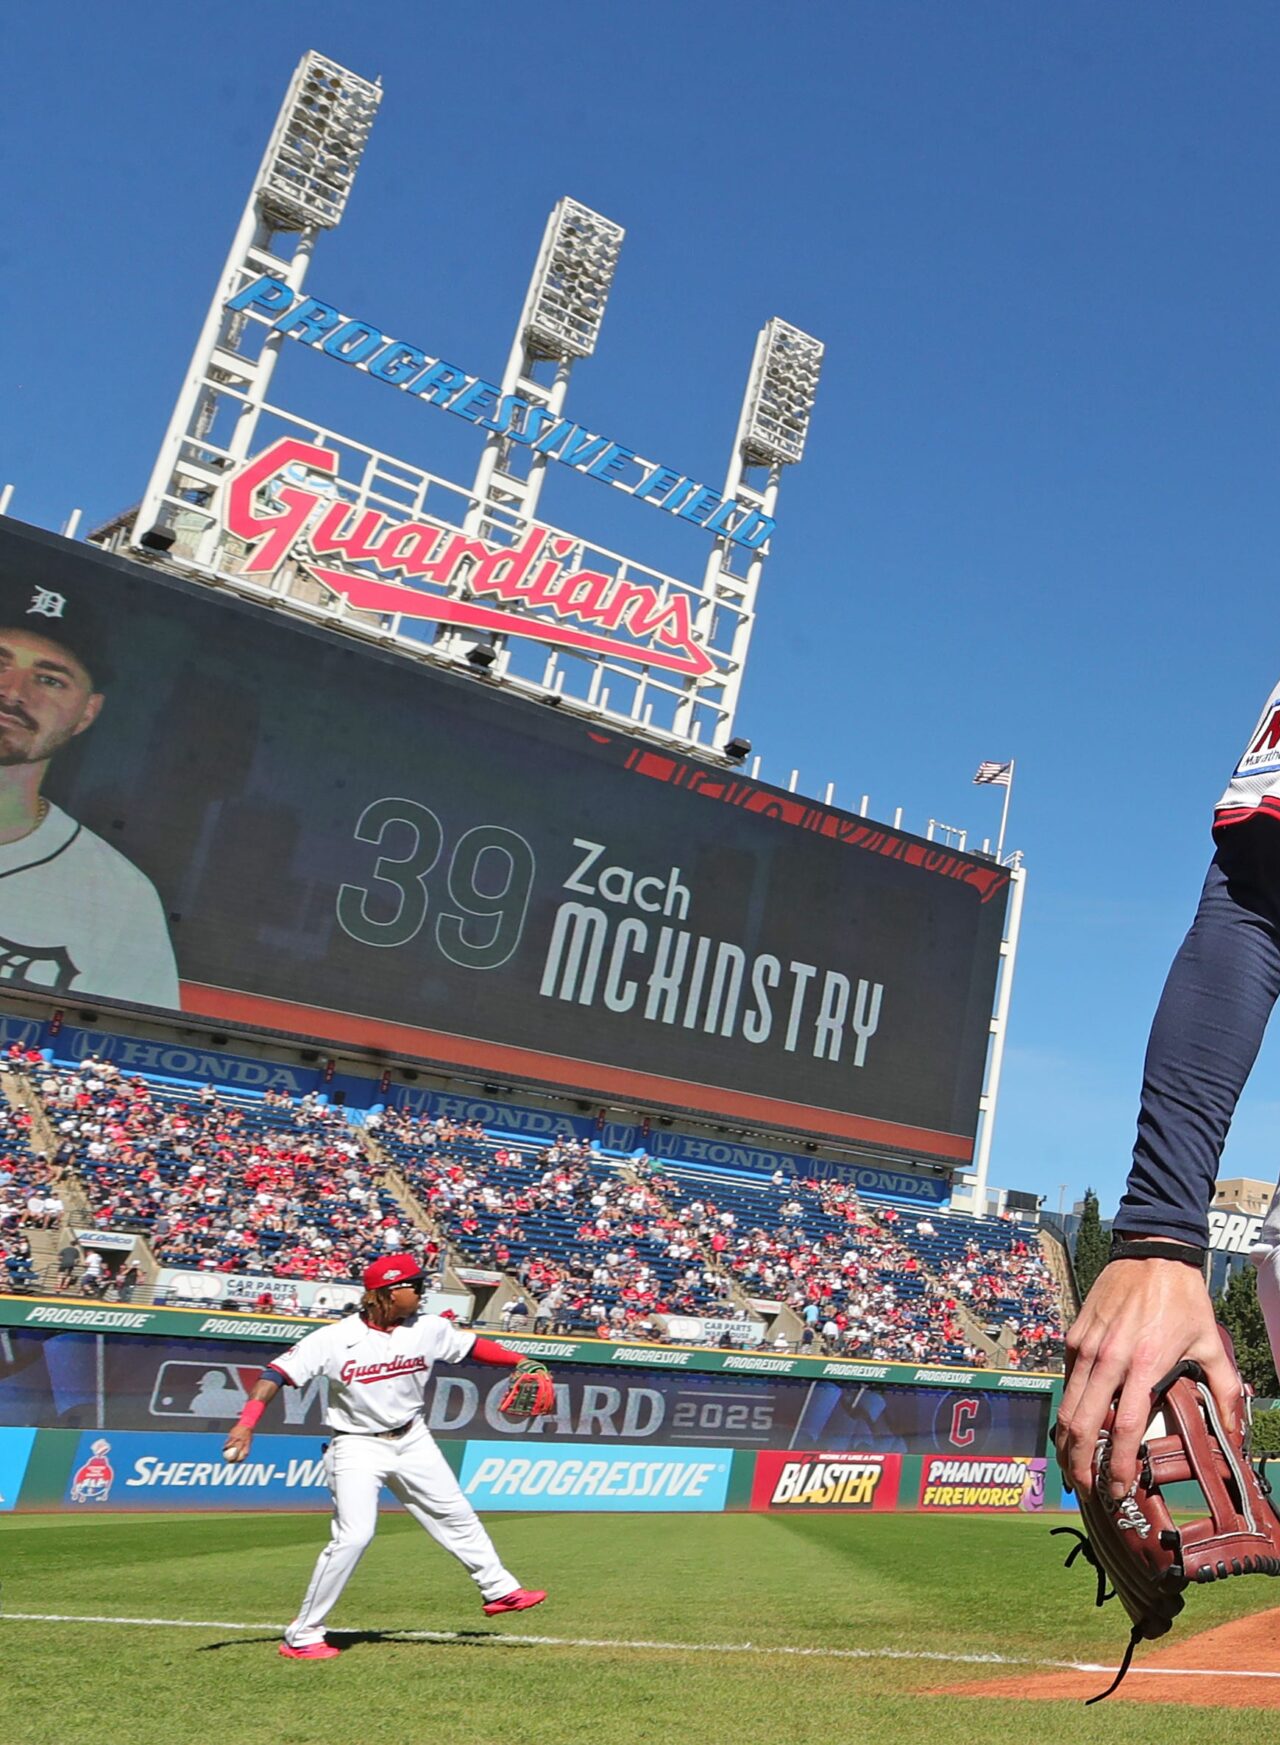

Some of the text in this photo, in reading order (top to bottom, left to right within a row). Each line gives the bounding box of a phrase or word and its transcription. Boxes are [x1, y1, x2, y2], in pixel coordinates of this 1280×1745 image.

[224, 276, 777, 549] PROGRESSIVE FIELD
[224, 436, 712, 664] Guardians
[336, 797, 536, 969] 39
[562, 838, 690, 920] Zach
[539, 901, 884, 1067] MCKINSTRY
[121, 1042, 300, 1092] HONDA
[436, 1098, 578, 1138] HONDA
[682, 1140, 799, 1175] HONDA
[836, 1161, 938, 1198] HONDA
[226, 1279, 297, 1293] CAR PARTS
[26, 1306, 148, 1328] PROGRESSIVE
[200, 1318, 309, 1338] PROGRESSIVE
[704, 1322, 752, 1332] CAR PARTS
[612, 1347, 691, 1365] PROGRESSIVE
[722, 1356, 794, 1372] PROGRESSIVE
[823, 1363, 888, 1379] PROGRESSIVE
[914, 1370, 973, 1384] PROGRESSIVE
[998, 1376, 1053, 1390] PROGRESSIVE
[671, 1402, 775, 1431] 2025
[126, 1457, 329, 1487] SHERWIN-WI
[464, 1458, 715, 1497] PROGRESSIVE
[771, 1463, 882, 1504] BLASTER
[928, 1460, 1027, 1485] PHANTOM
[923, 1485, 1022, 1506] FIREWORKS
